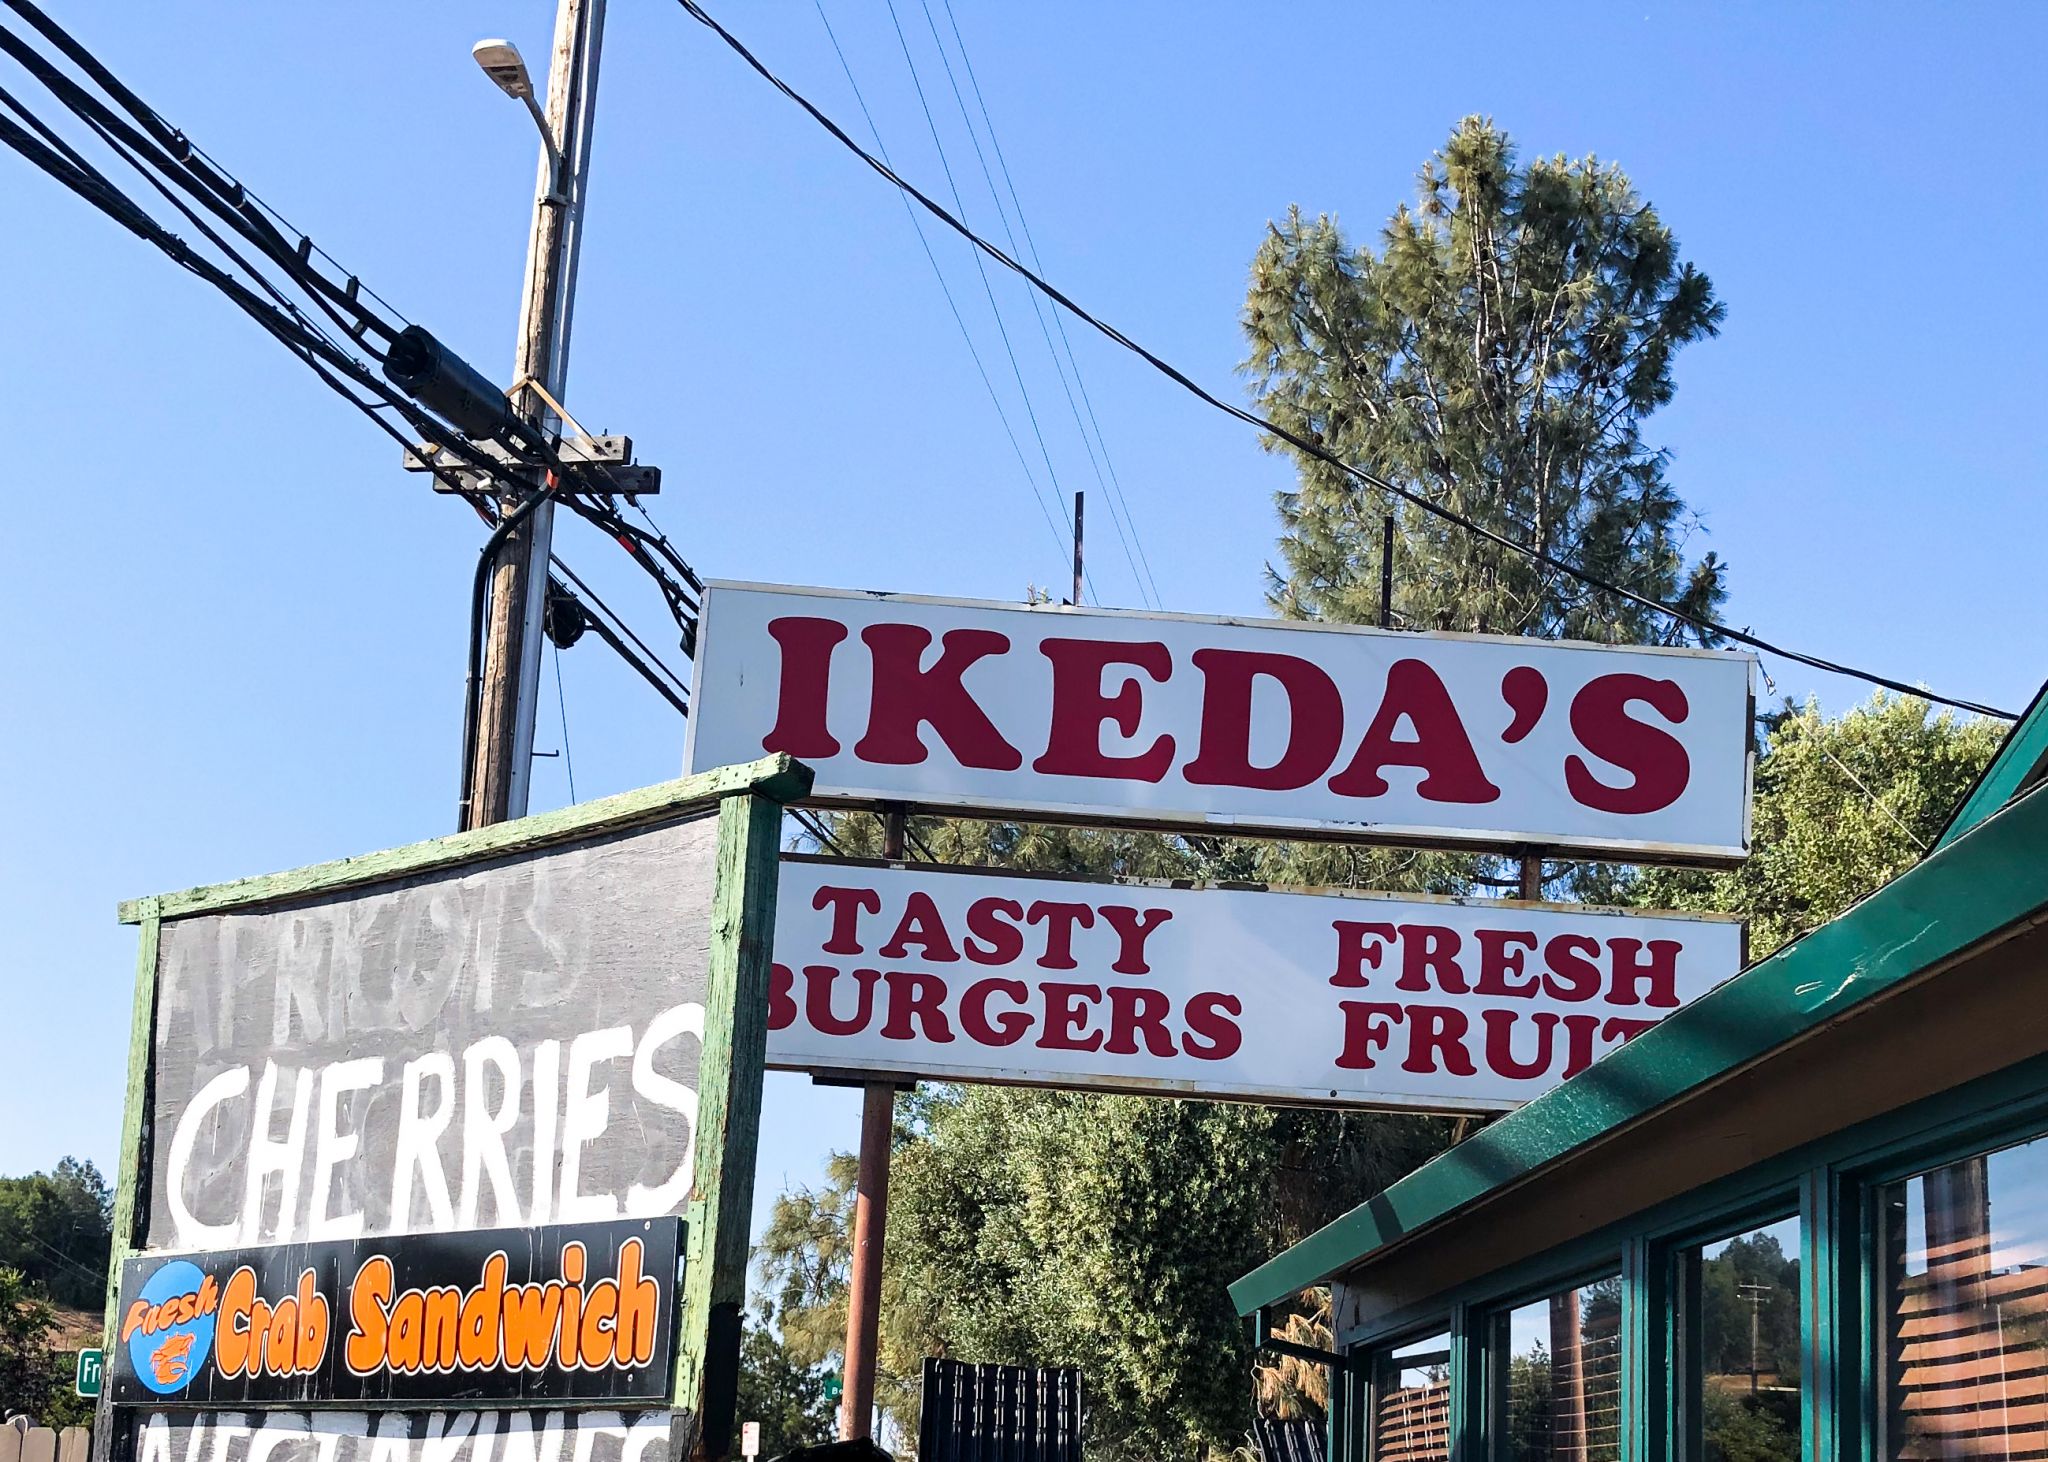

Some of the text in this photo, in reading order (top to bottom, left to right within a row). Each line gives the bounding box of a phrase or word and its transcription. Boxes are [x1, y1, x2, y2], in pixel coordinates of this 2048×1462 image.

[762, 616, 1690, 815] IKEDA'S
[812, 885, 1173, 976] TASTY
[1329, 919, 1683, 1008] FRESH
[166, 1002, 706, 1250] CHERRIES
[121, 1236, 660, 1380] Fresh Crab Sandwich
[83, 1357, 102, 1383] Fr
